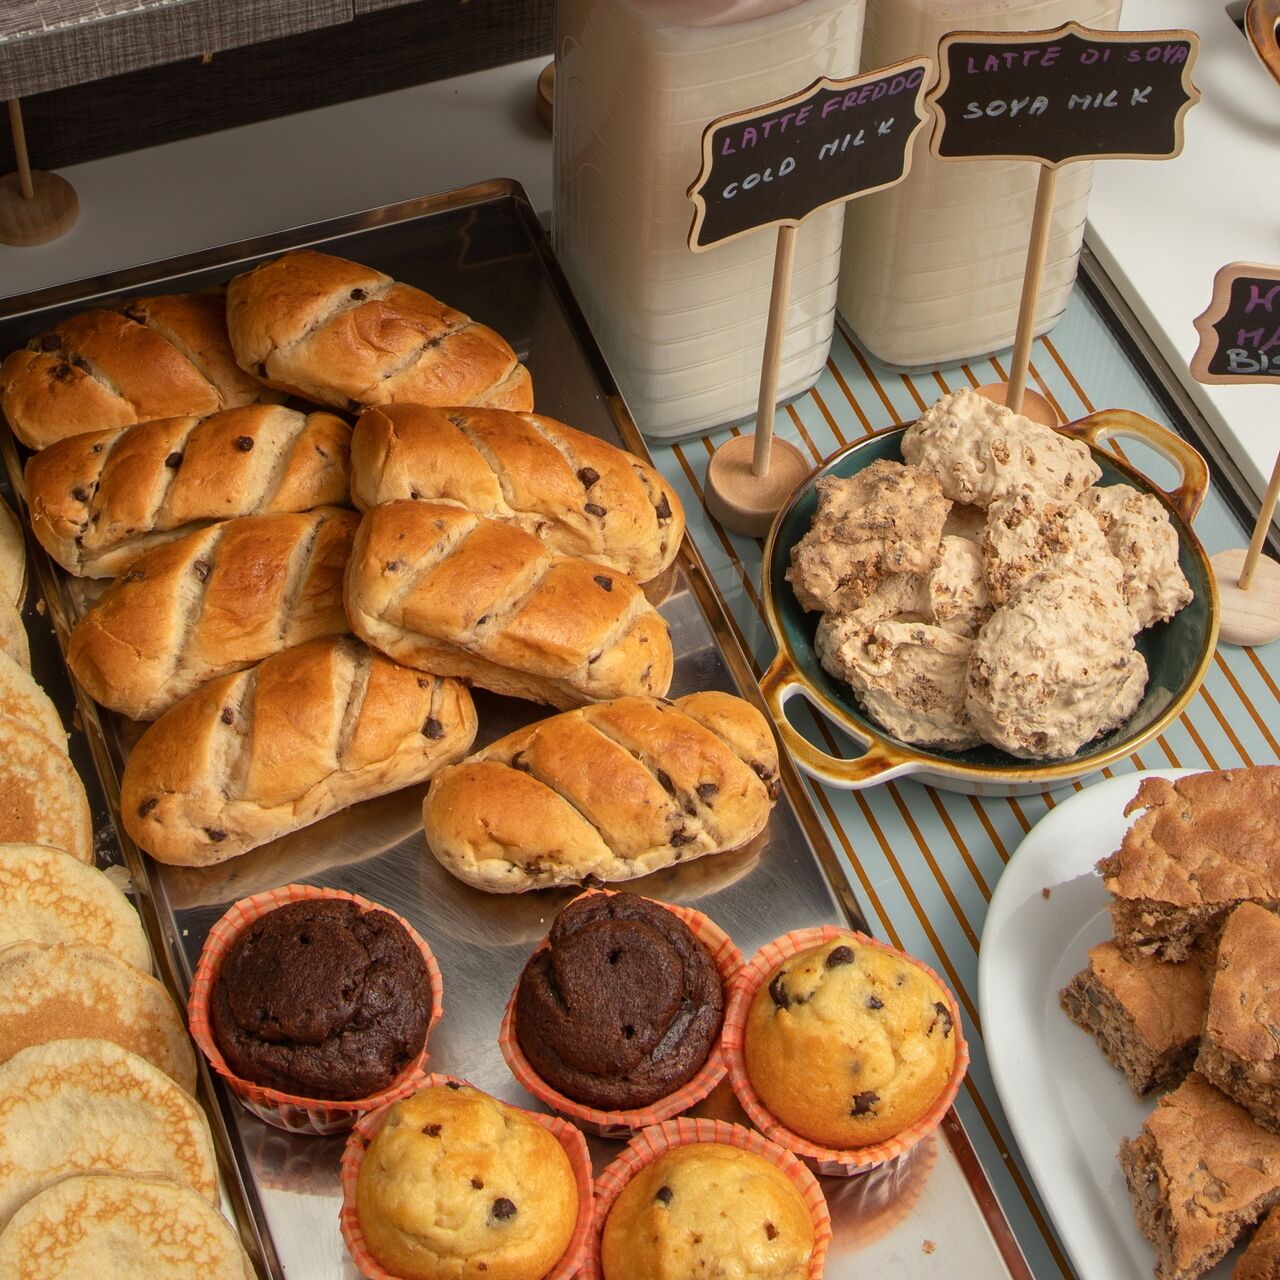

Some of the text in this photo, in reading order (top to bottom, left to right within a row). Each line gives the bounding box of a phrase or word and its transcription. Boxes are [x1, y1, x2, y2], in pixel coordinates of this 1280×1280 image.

[967, 44, 1189, 73] LATTE DI SOYA
[721, 70, 925, 156] LATTE FREDDO
[963, 86, 1152, 119] SOYA MILK
[723, 118, 894, 199] COLD MILK
